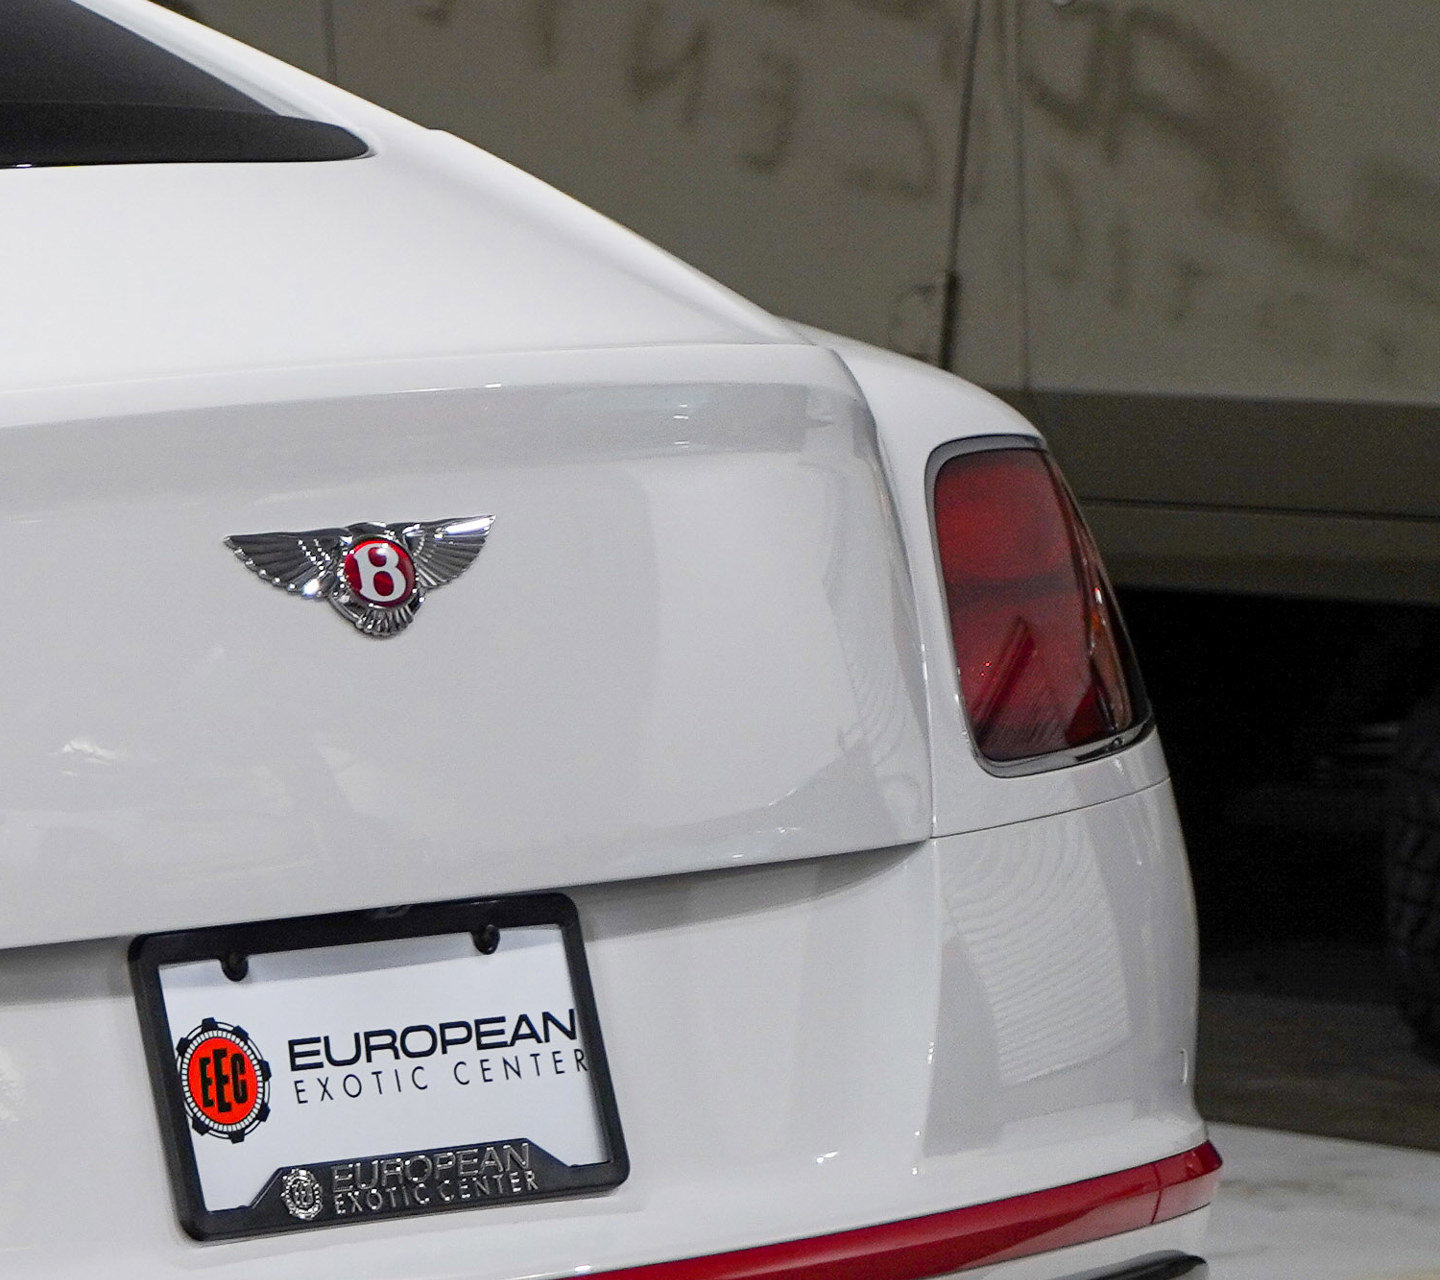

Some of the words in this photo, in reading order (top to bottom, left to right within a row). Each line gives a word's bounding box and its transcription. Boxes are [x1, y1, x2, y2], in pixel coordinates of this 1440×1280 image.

[287, 1008, 577, 1072] EUROPEAN
[199, 1047, 249, 1114] EEC
[293, 1065, 429, 1105] EXOTIC
[453, 1048, 589, 1086] CENTER
[331, 1142, 531, 1192] EUROPEAN
[334, 1183, 430, 1214] EXOTIC
[437, 1170, 540, 1202] CENTER
